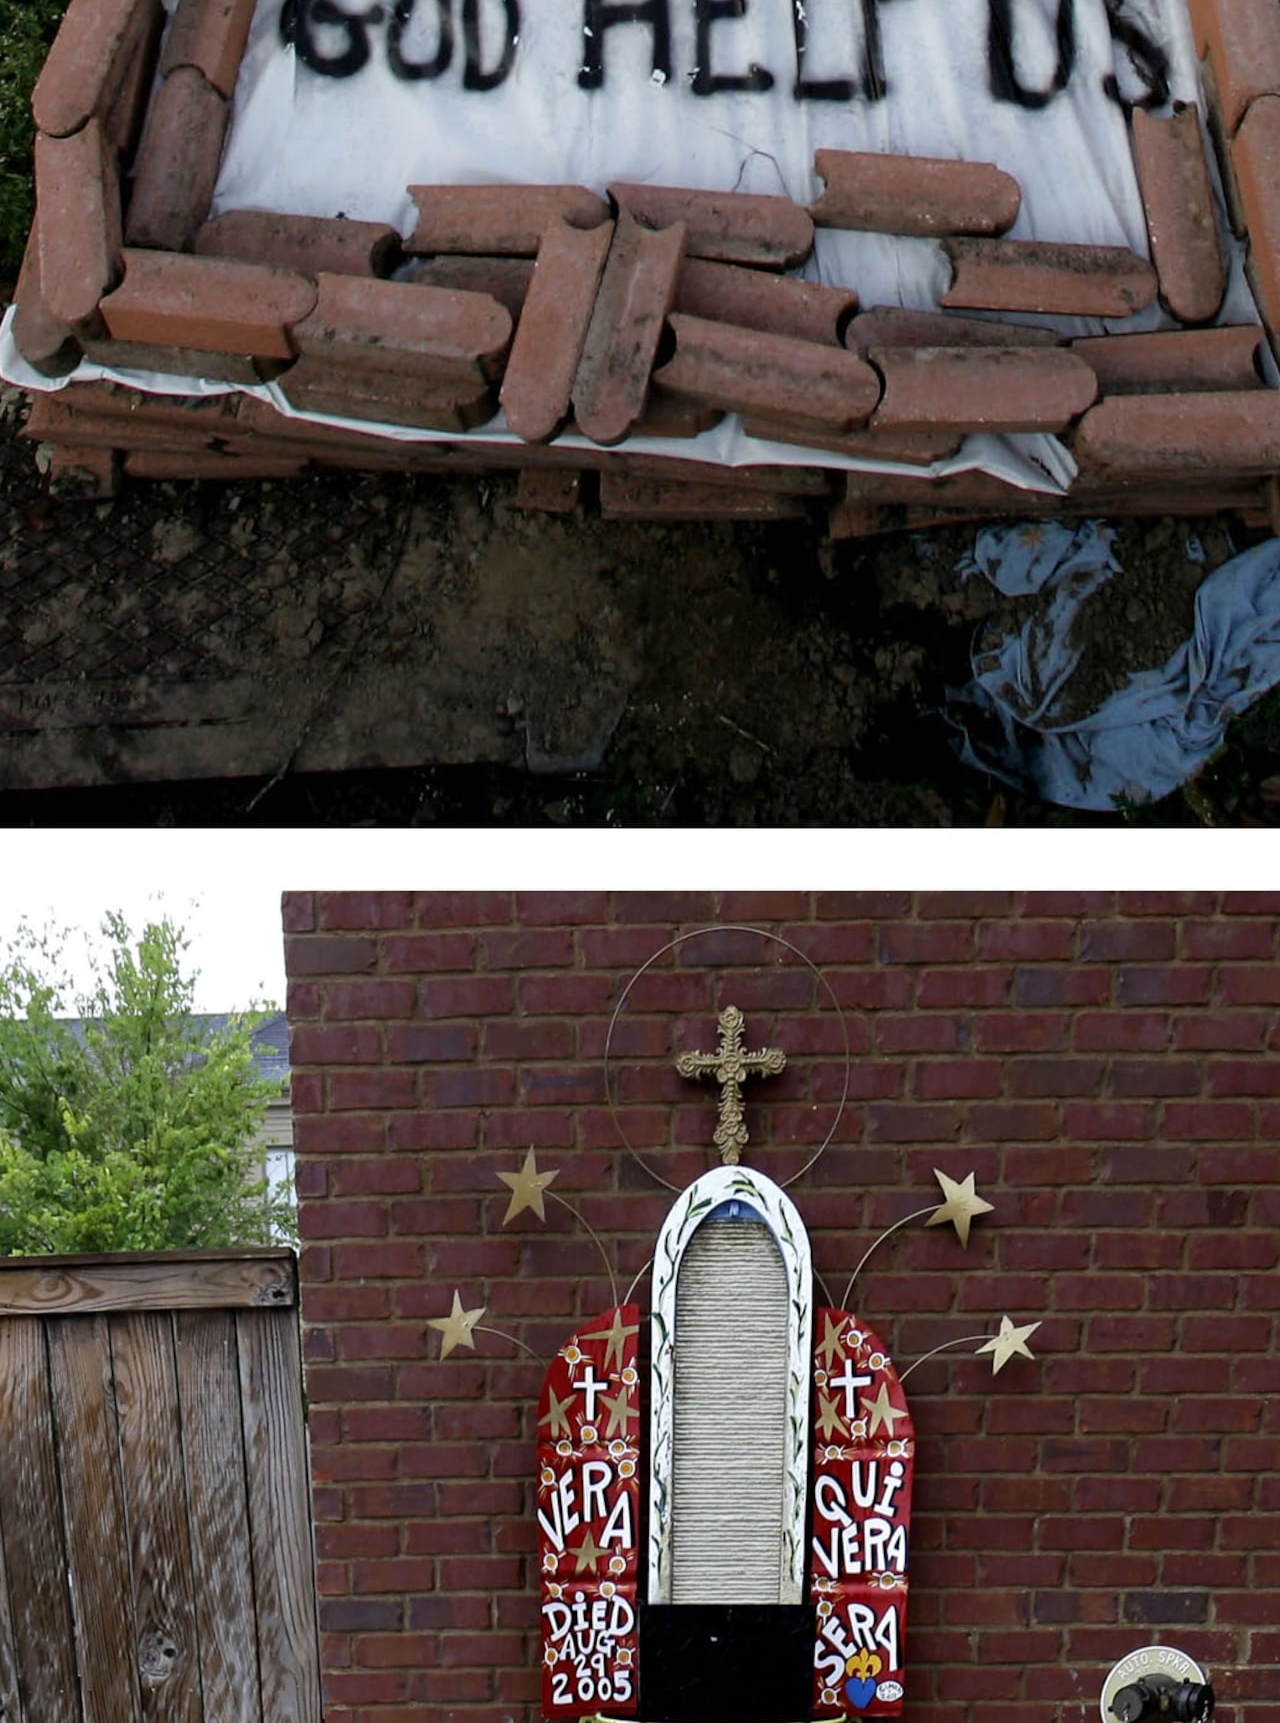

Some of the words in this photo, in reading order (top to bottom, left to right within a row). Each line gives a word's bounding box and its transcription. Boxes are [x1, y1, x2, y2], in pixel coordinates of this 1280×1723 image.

[537, 1461, 633, 1553] VERA
[813, 1518, 907, 1580] VERA
[559, 1630, 615, 1662] AUG
[813, 1603, 898, 1687] SERA
[1158, 1650, 1191, 1674] SPKR
[574, 1654, 605, 1678] 29
[552, 1669, 632, 1706] 2005
